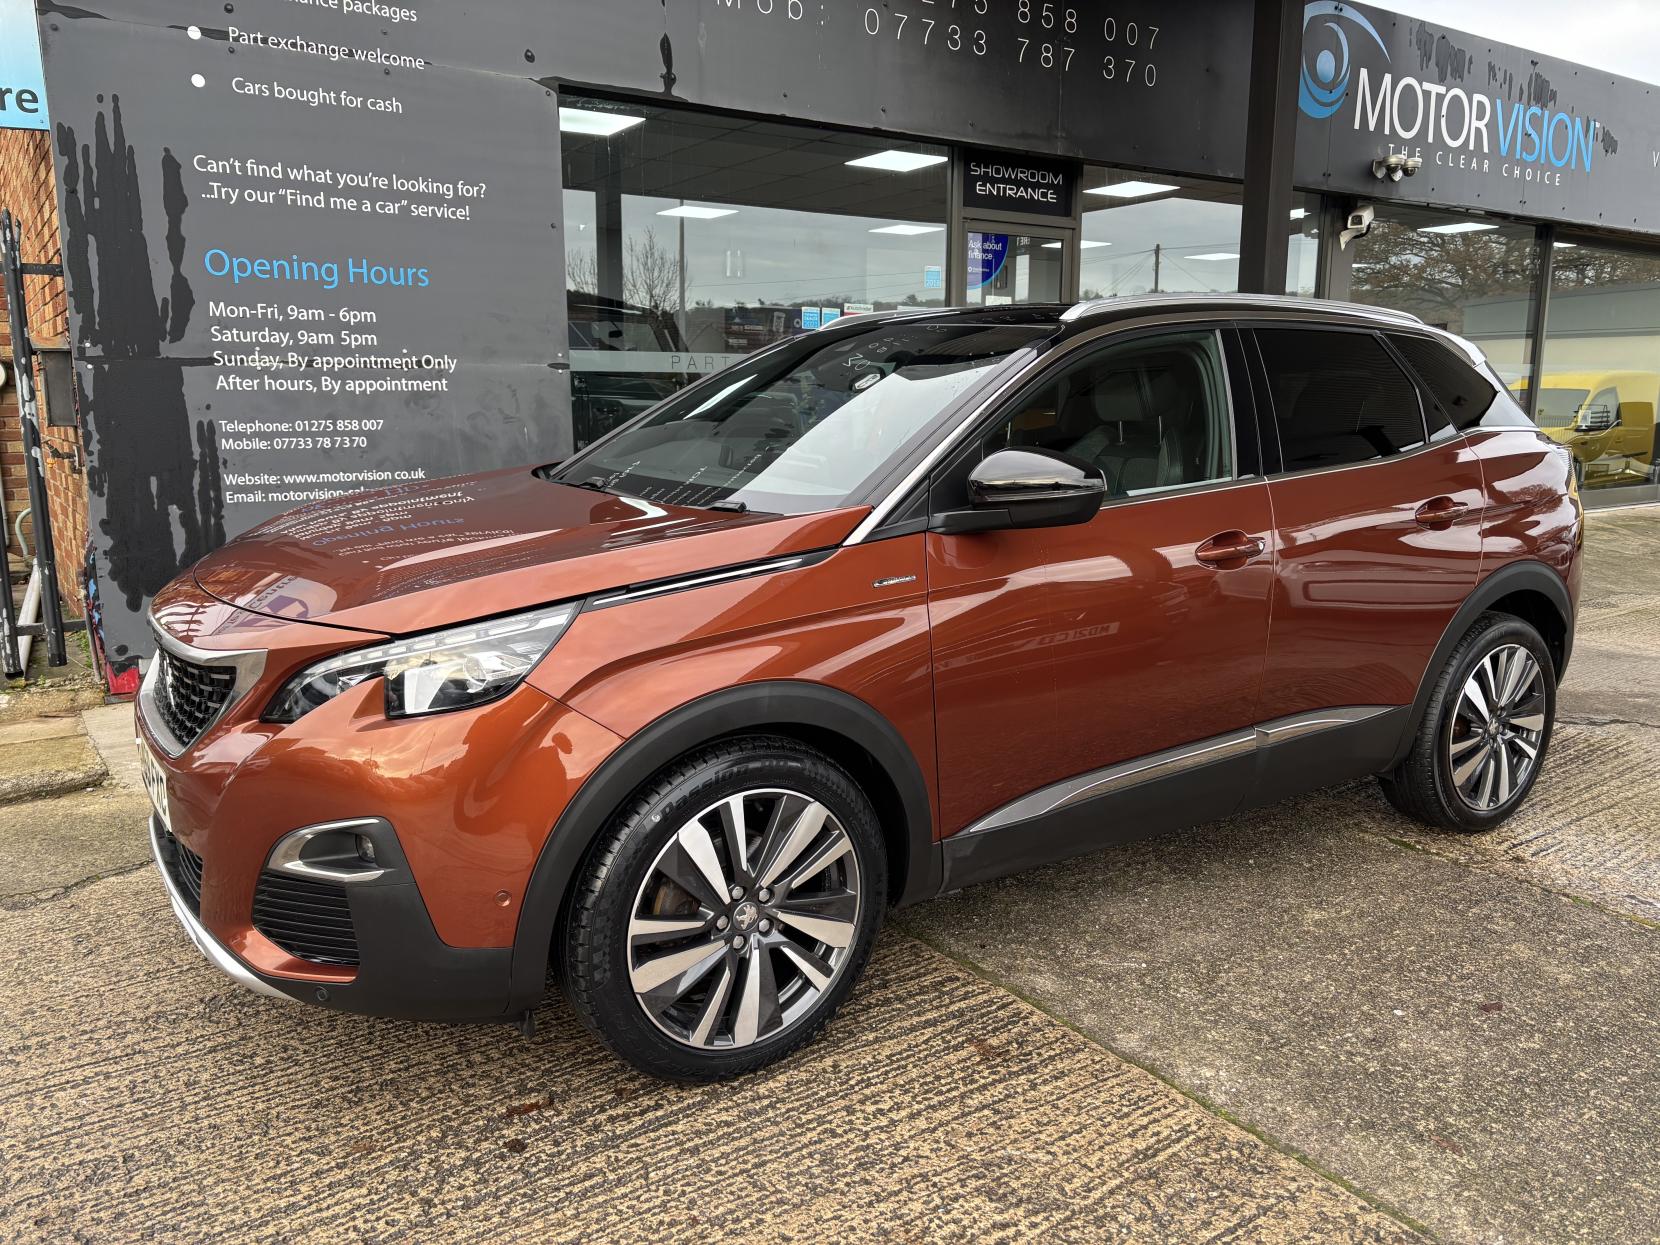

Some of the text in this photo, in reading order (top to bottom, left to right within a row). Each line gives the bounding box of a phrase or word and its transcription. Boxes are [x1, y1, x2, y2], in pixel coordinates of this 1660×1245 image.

[342, 0, 418, 23] packages
[1017, 0, 1077, 33] 858
[1104, 18, 1159, 49] 007
[228, 26, 425, 70] Part exchange welcome
[864, 8, 1156, 87] 07733 787 370
[231, 77, 403, 114] Cars bought for cash
[969, 162, 1063, 185] SHOWROOM
[1388, 143, 1561, 186] THE CLEAR CHOICE
[193, 154, 487, 199] Can’t find what you’re looking for?
[976, 181, 1057, 202] ENTRANCE
[243, 189, 277, 204] our
[329, 197, 358, 211] me
[361, 199, 372, 213] a
[410, 203, 471, 221] service!
[968, 239, 1002, 251] Ask about
[968, 249, 993, 260] finance
[204, 248, 430, 289] Opening Hours
[209, 301, 284, 322] Mon-Fri,
[287, 304, 325, 321] 9am
[338, 307, 377, 326] 6pm
[210, 325, 378, 349] Saturday, 9am 5pm
[212, 350, 458, 374] Sunday, By appointment Only
[671, 354, 731, 370] PART
[215, 374, 449, 395] After hours, By appointment
[218, 419, 384, 435] Telephone: 01275 858 007
[221, 437, 271, 450] Mobile:
[273, 437, 313, 450] 07733
[223, 472, 281, 486] Website:
[225, 489, 267, 504] Email:
